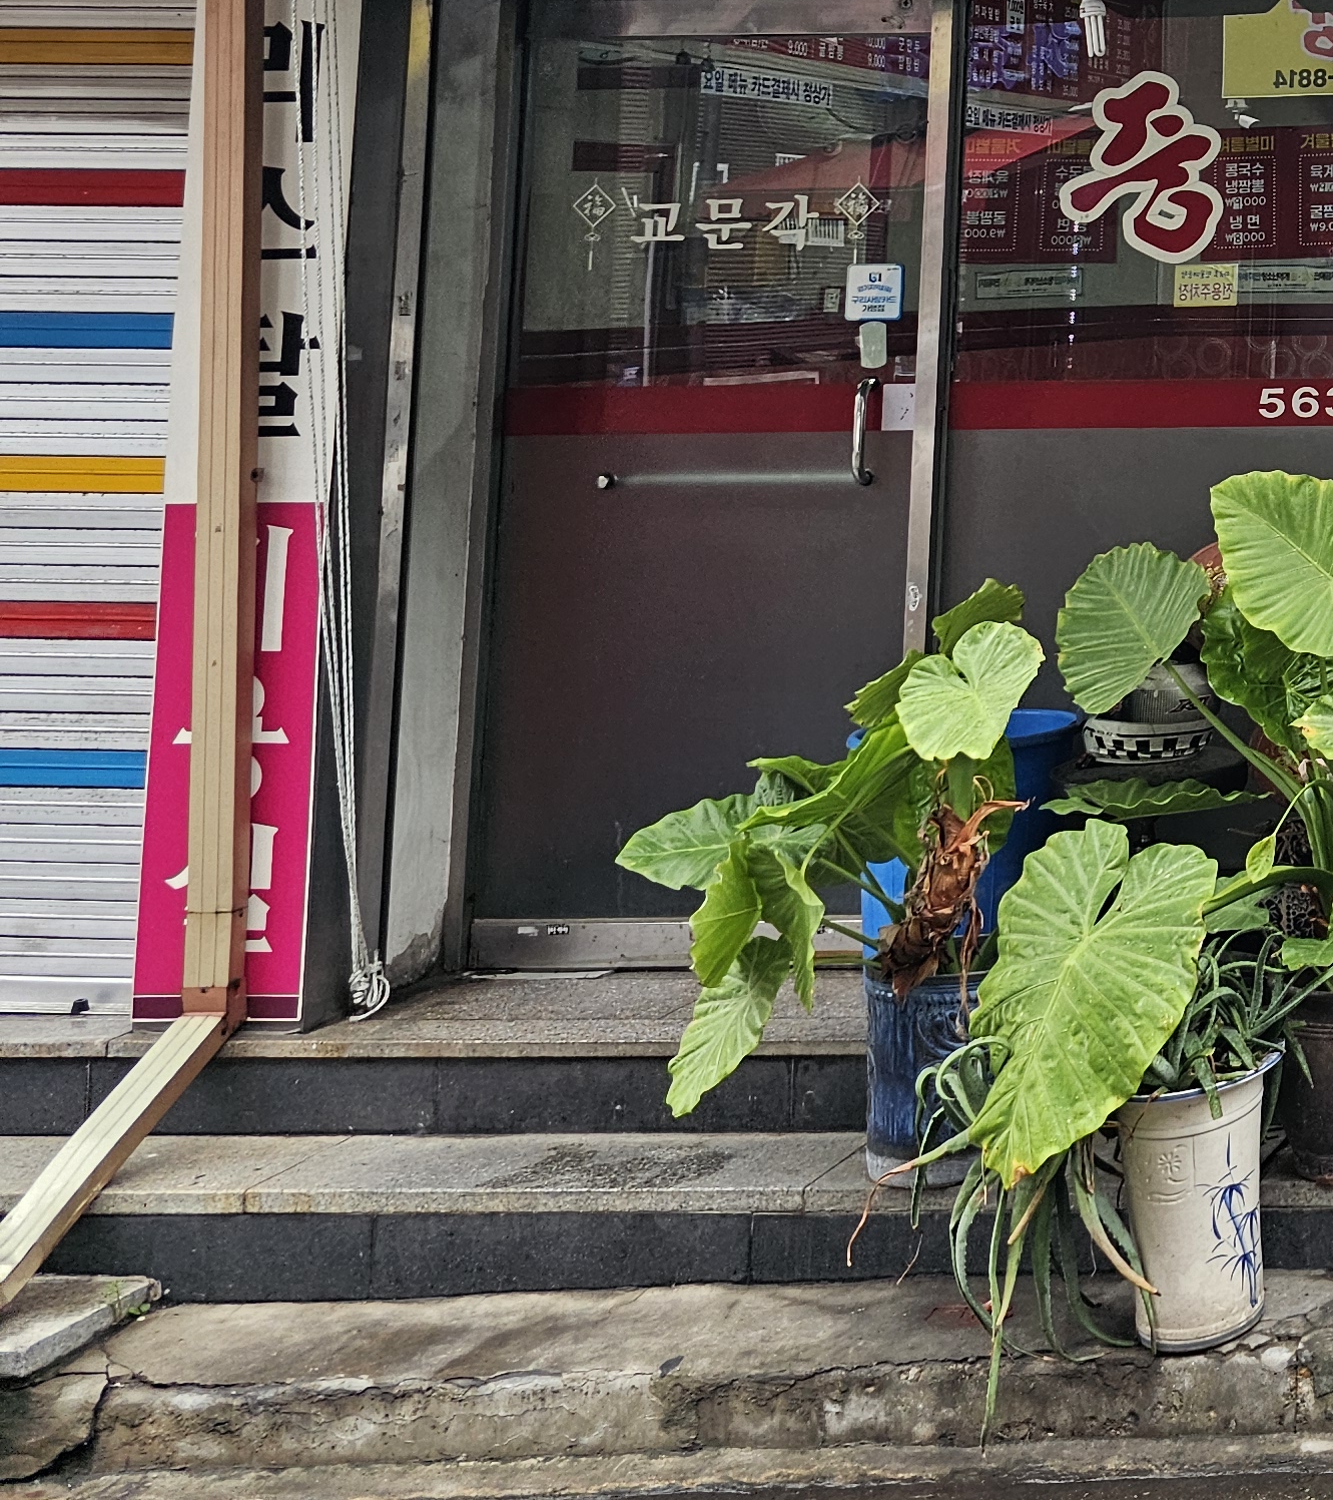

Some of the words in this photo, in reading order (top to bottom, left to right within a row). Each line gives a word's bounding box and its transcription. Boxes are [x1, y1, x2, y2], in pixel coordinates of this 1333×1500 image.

[1226, 163, 1264, 177] 콩국수
[1226, 179, 1264, 194] 냉짬뽕
[630, 194, 819, 250] 교문각
